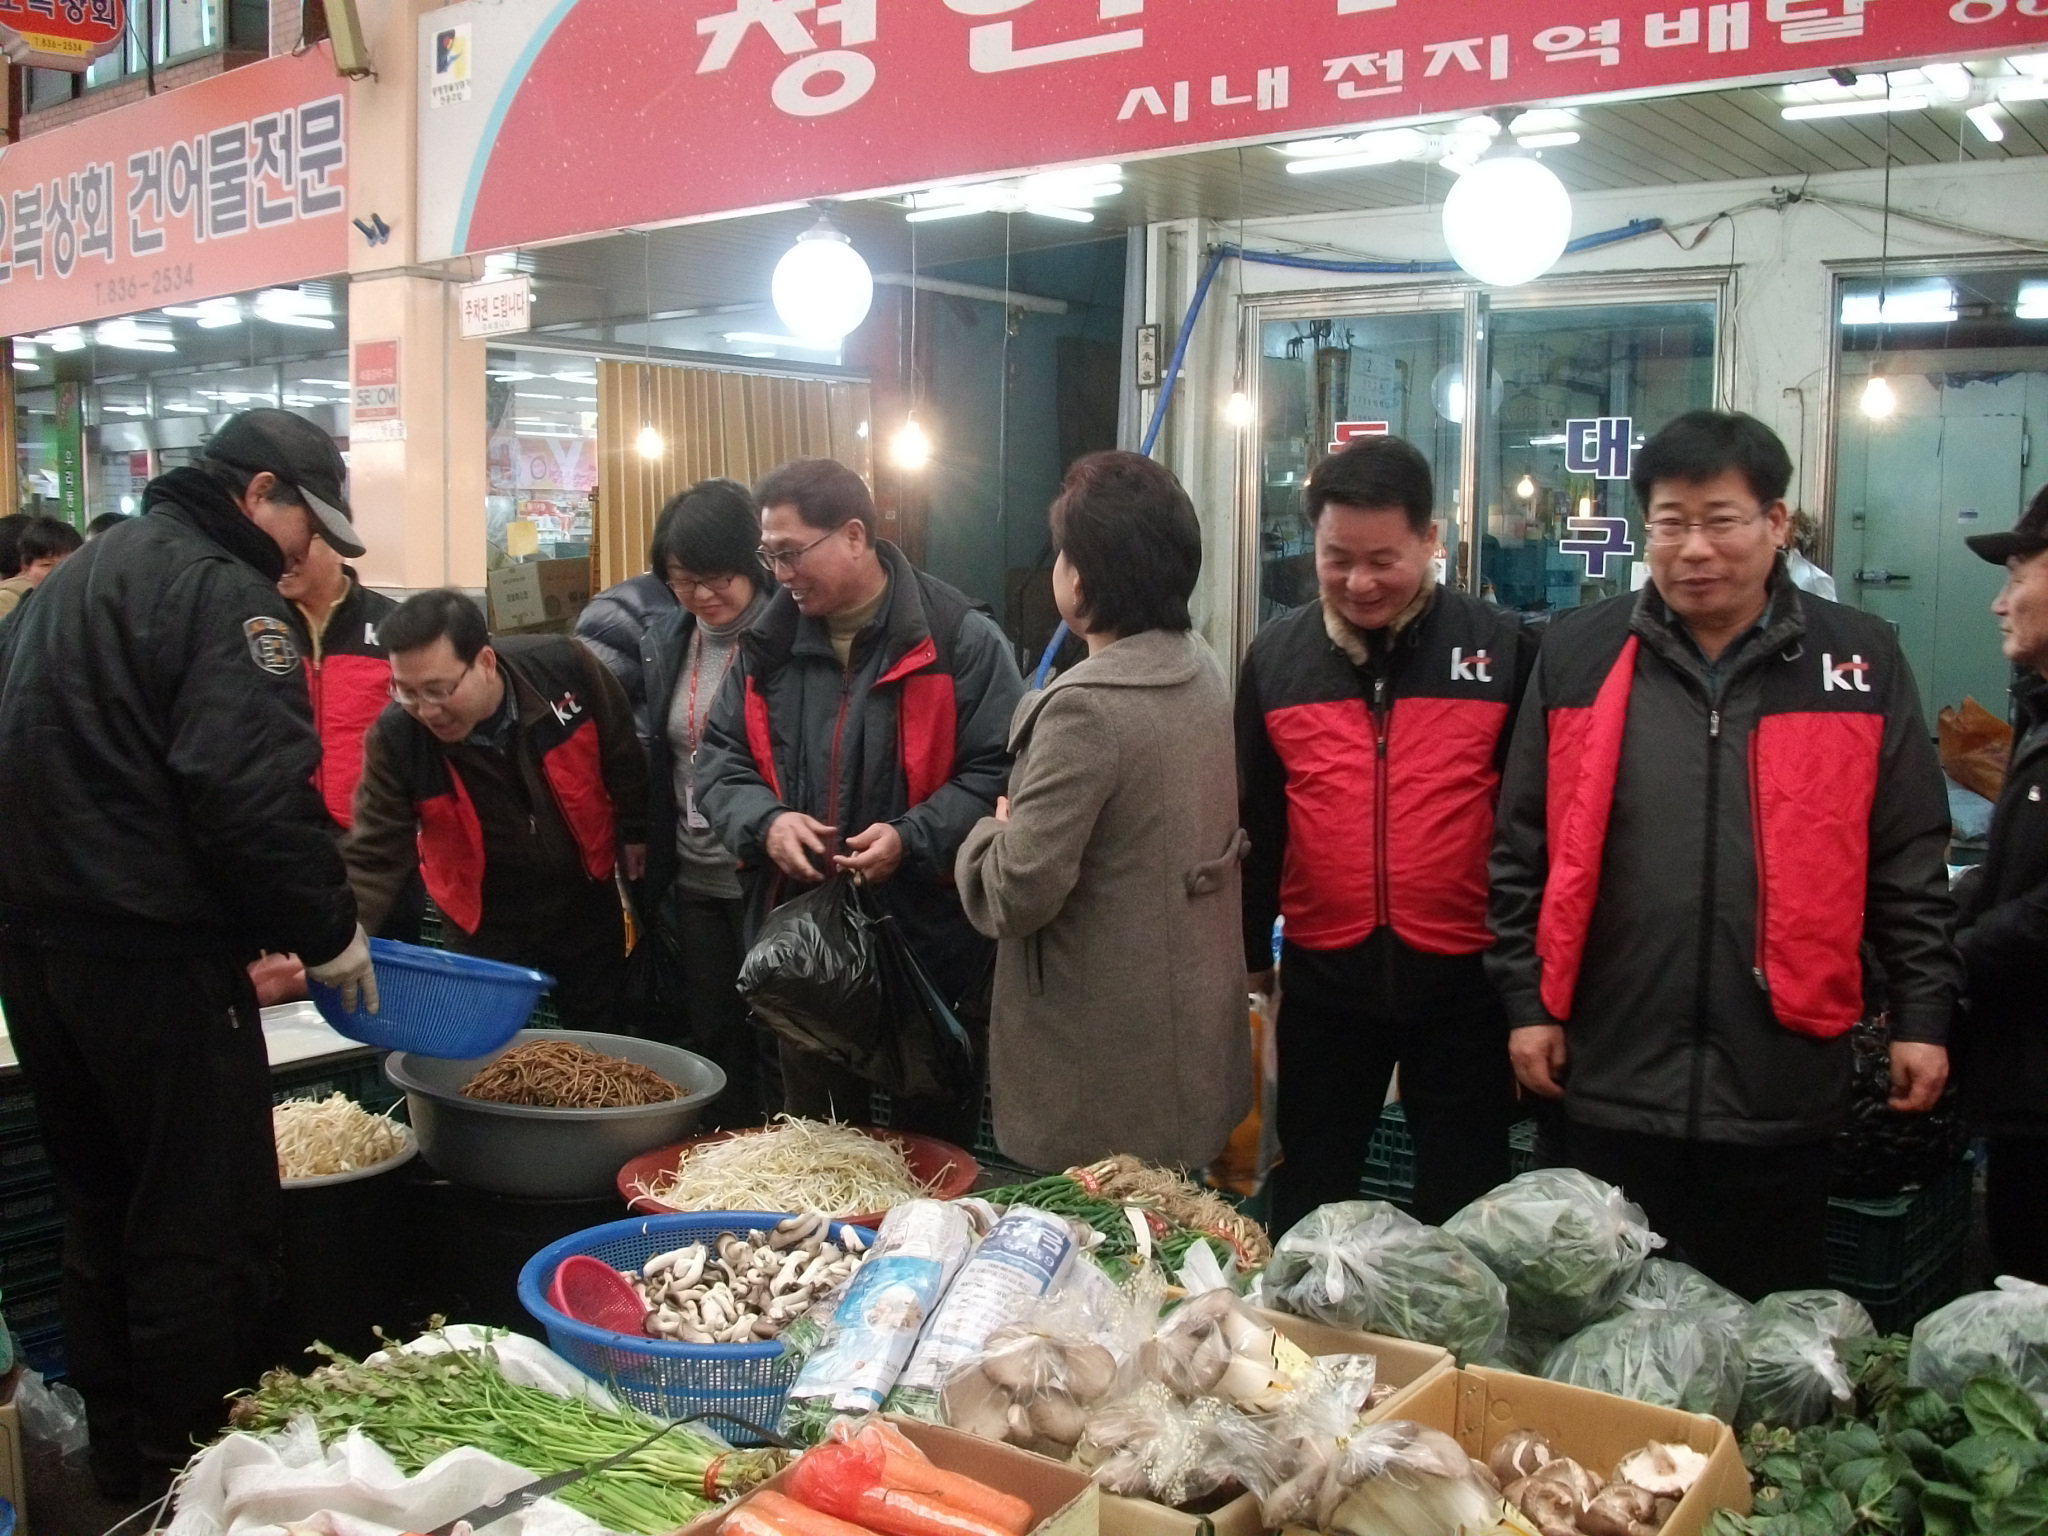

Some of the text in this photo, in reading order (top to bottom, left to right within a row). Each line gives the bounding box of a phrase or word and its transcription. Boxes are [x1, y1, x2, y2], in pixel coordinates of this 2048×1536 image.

[127, 94, 345, 257] 건어물전문
[465, 290, 525, 324] 주차권 드립니다
[1559, 417, 1634, 578] 대구
[364, 622, 380, 646] k
[1450, 646, 1493, 683] kt
[1822, 652, 1871, 692] kt
[550, 691, 583, 727] kt
